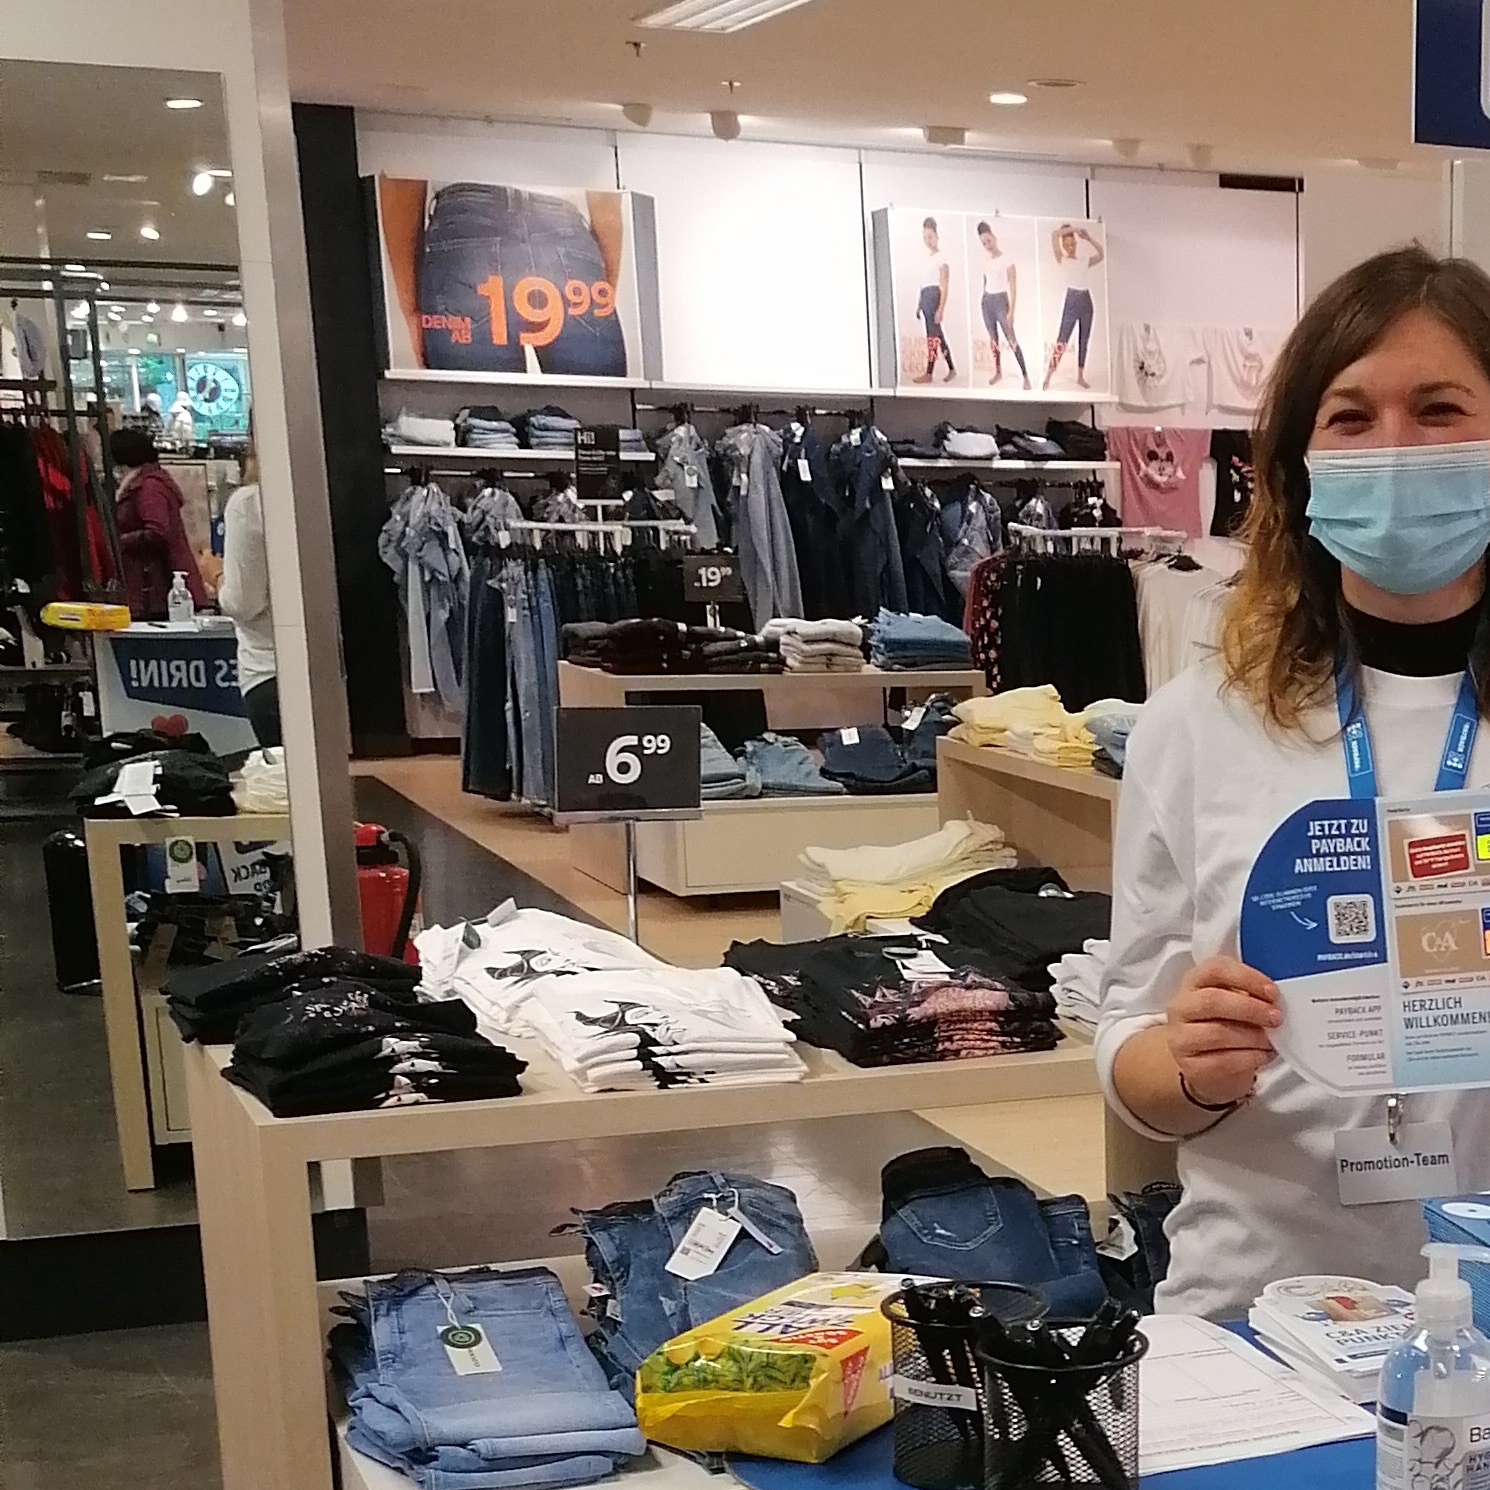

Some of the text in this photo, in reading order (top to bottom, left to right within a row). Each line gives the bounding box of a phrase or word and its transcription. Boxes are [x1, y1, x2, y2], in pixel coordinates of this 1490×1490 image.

[421, 313, 472, 330] DENIM
[451, 330, 473, 344] AB
[588, 773, 604, 784] AB
[1307, 818, 1368, 837] JETZT ZU
[1311, 836, 1371, 855] PAYBACK
[1294, 855, 1372, 875] ANMELDEN!
[1402, 996, 1463, 1013] HERZLICH
[1340, 1152, 1450, 1174] Promotion-Team
